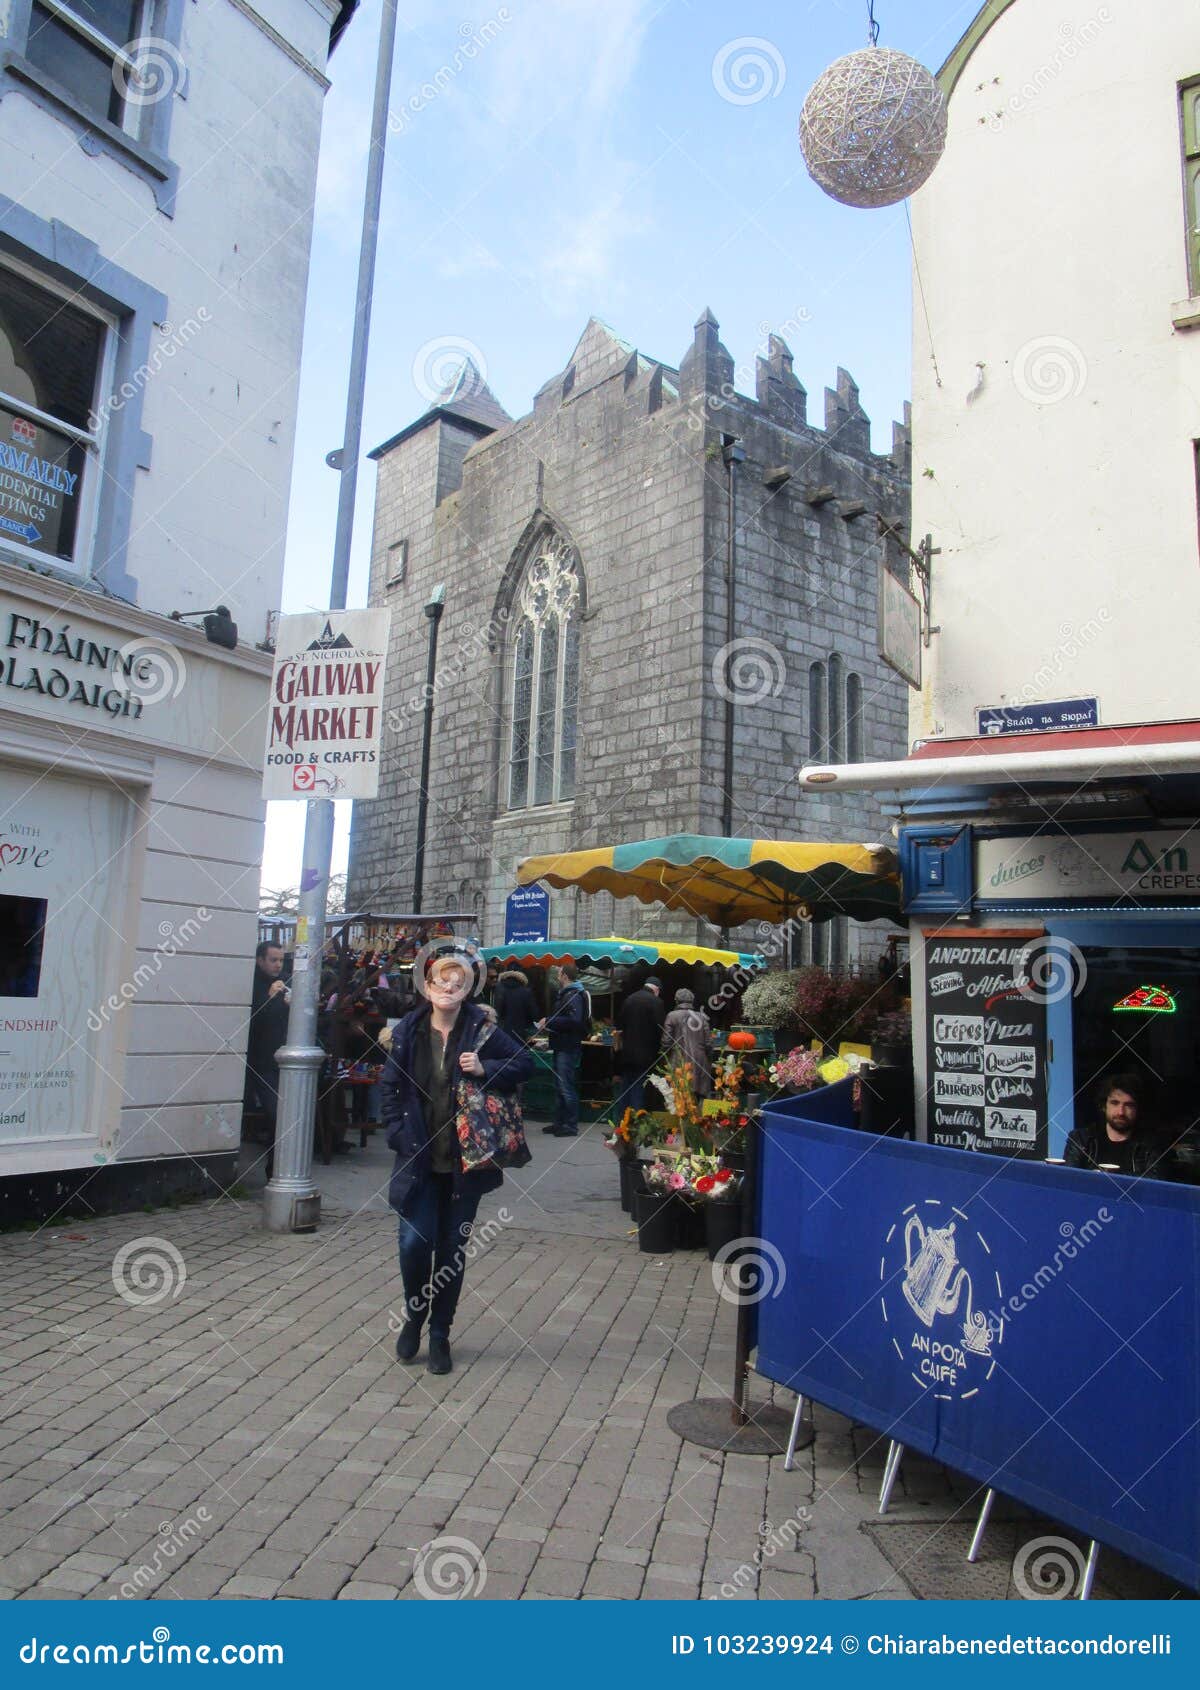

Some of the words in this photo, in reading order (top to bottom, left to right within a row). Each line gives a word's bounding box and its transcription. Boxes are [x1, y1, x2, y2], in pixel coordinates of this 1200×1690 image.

[311, 650, 366, 661] NICHOLAS
[275, 661, 381, 704] GALWAY
[269, 705, 379, 750] MARKET
[267, 753, 304, 765] FOOD
[309, 752, 319, 763] &
[324, 751, 376, 763] CRAFTS
[10, 823, 40, 837] WITH
[1120, 837, 1189, 874] An
[966, 971, 1030, 998] Alfredo
[990, 1111, 1029, 1133] Pasta
[911, 1332, 930, 1353] AN
[932, 1341, 967, 1369] POTA
[920, 1358, 958, 1386] CAIFE
